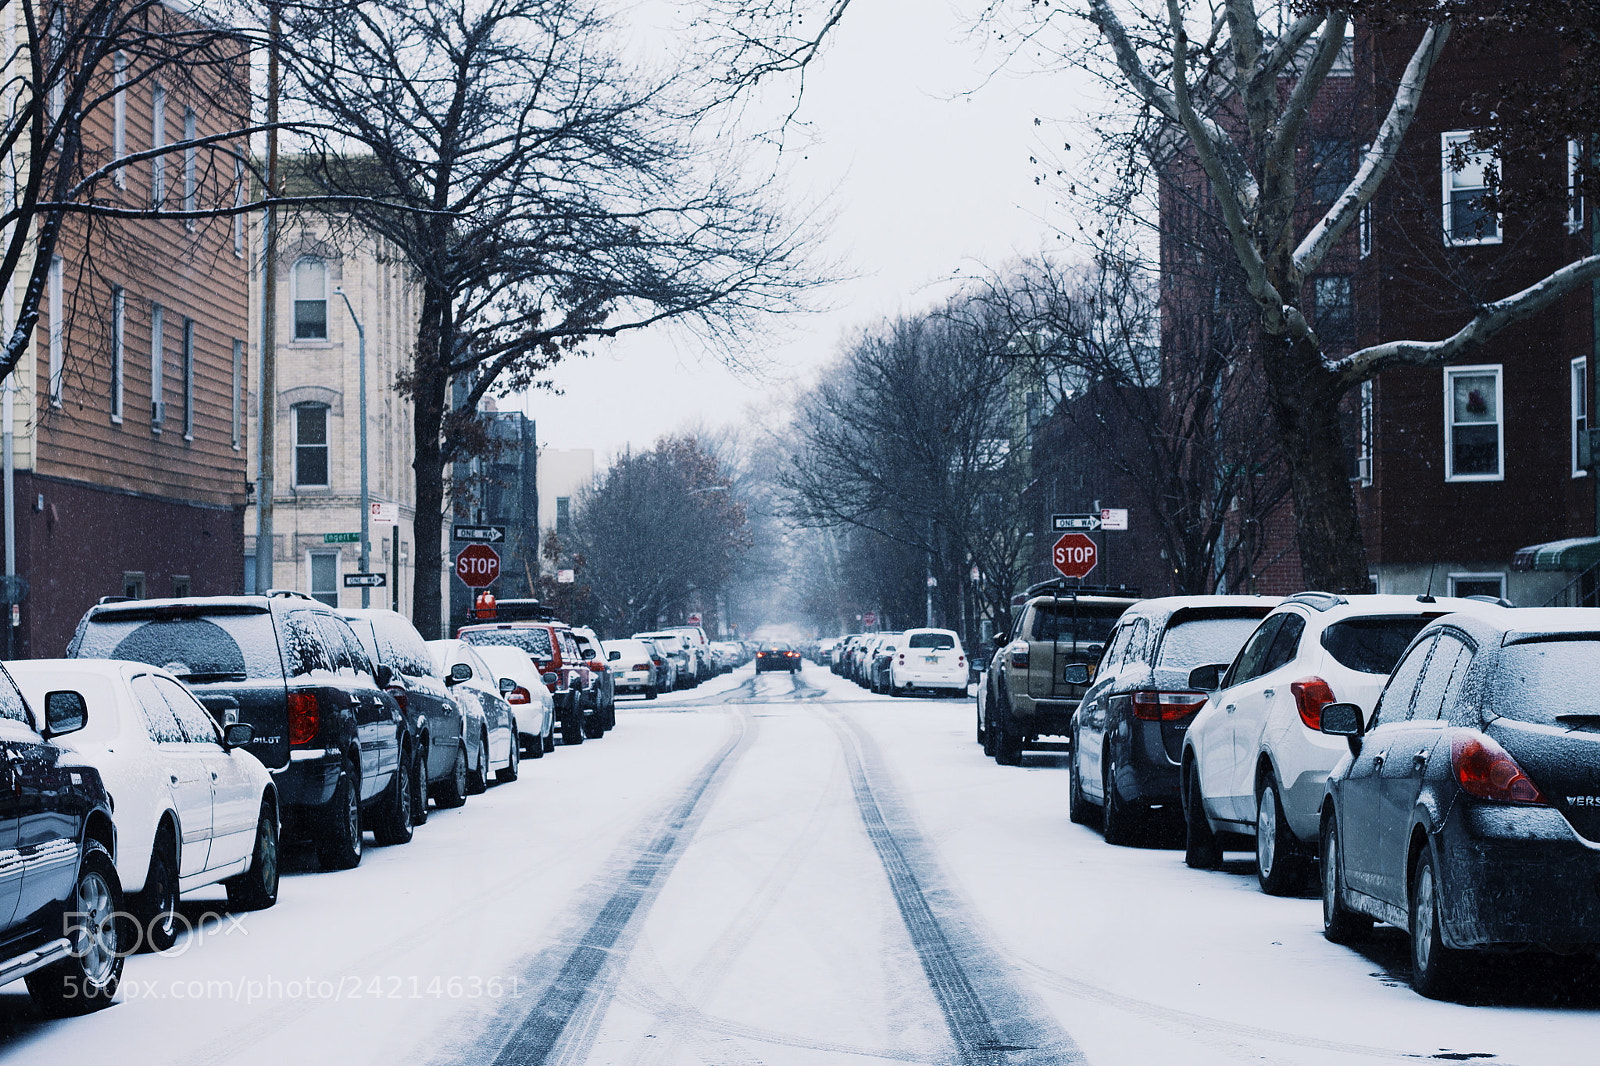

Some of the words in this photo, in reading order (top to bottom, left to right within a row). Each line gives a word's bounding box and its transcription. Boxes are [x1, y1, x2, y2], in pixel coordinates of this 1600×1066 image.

[1060, 519, 1075, 527] ONE
[1081, 519, 1097, 527] WAY
[460, 530, 475, 538] ONE
[482, 530, 498, 538] WAY
[1056, 547, 1094, 563] STOP
[459, 557, 498, 574] STOP
[367, 576, 380, 584] WAY
[252, 735, 281, 744] PILOT
